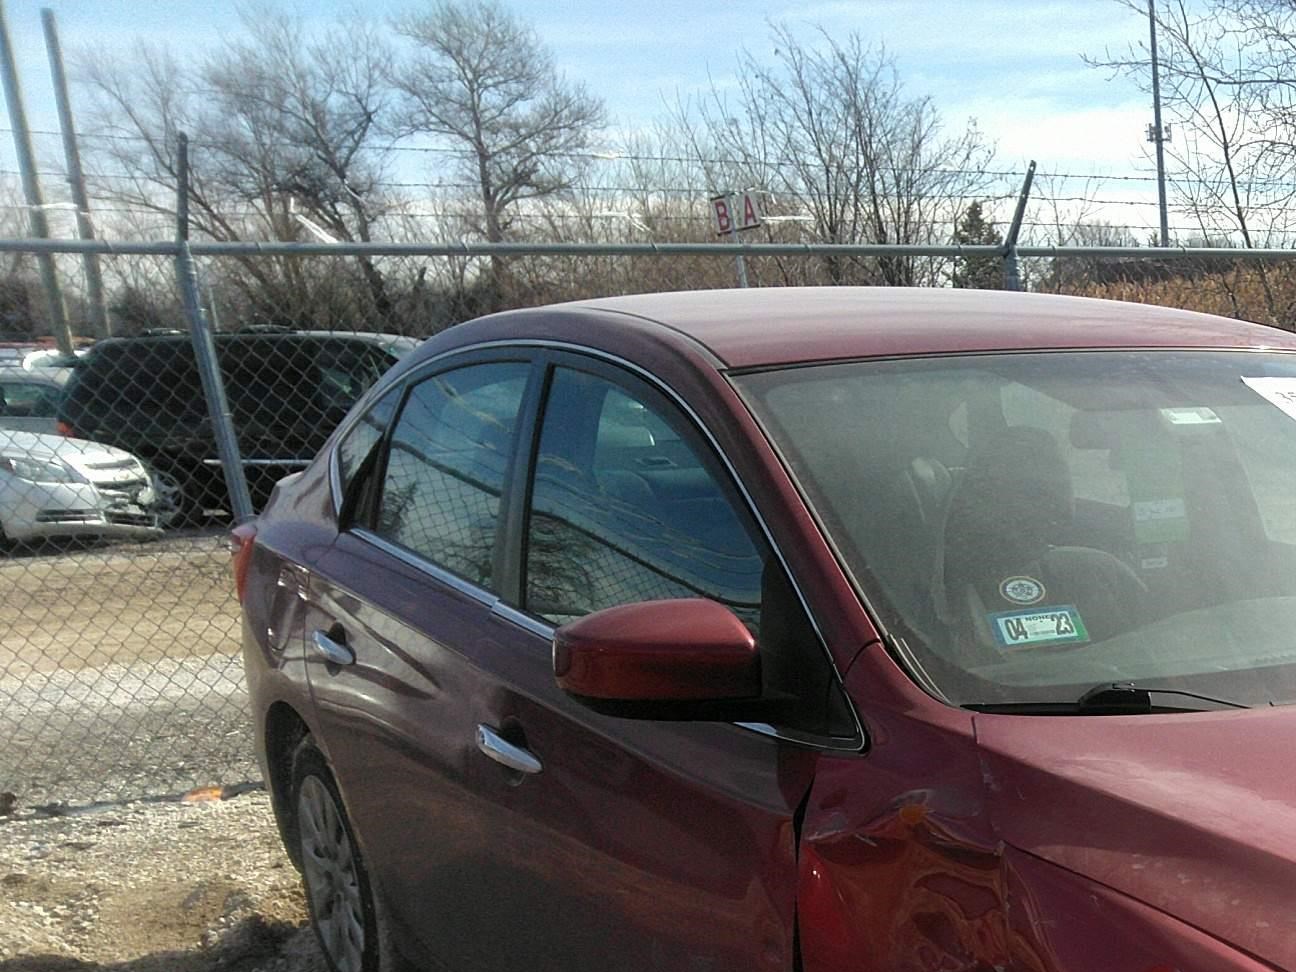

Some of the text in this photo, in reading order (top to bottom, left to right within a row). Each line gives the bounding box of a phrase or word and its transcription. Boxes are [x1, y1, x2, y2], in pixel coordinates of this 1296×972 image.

[714, 194, 758, 231] B A
[1004, 618, 1028, 640] 04
[1051, 612, 1074, 635] 23
